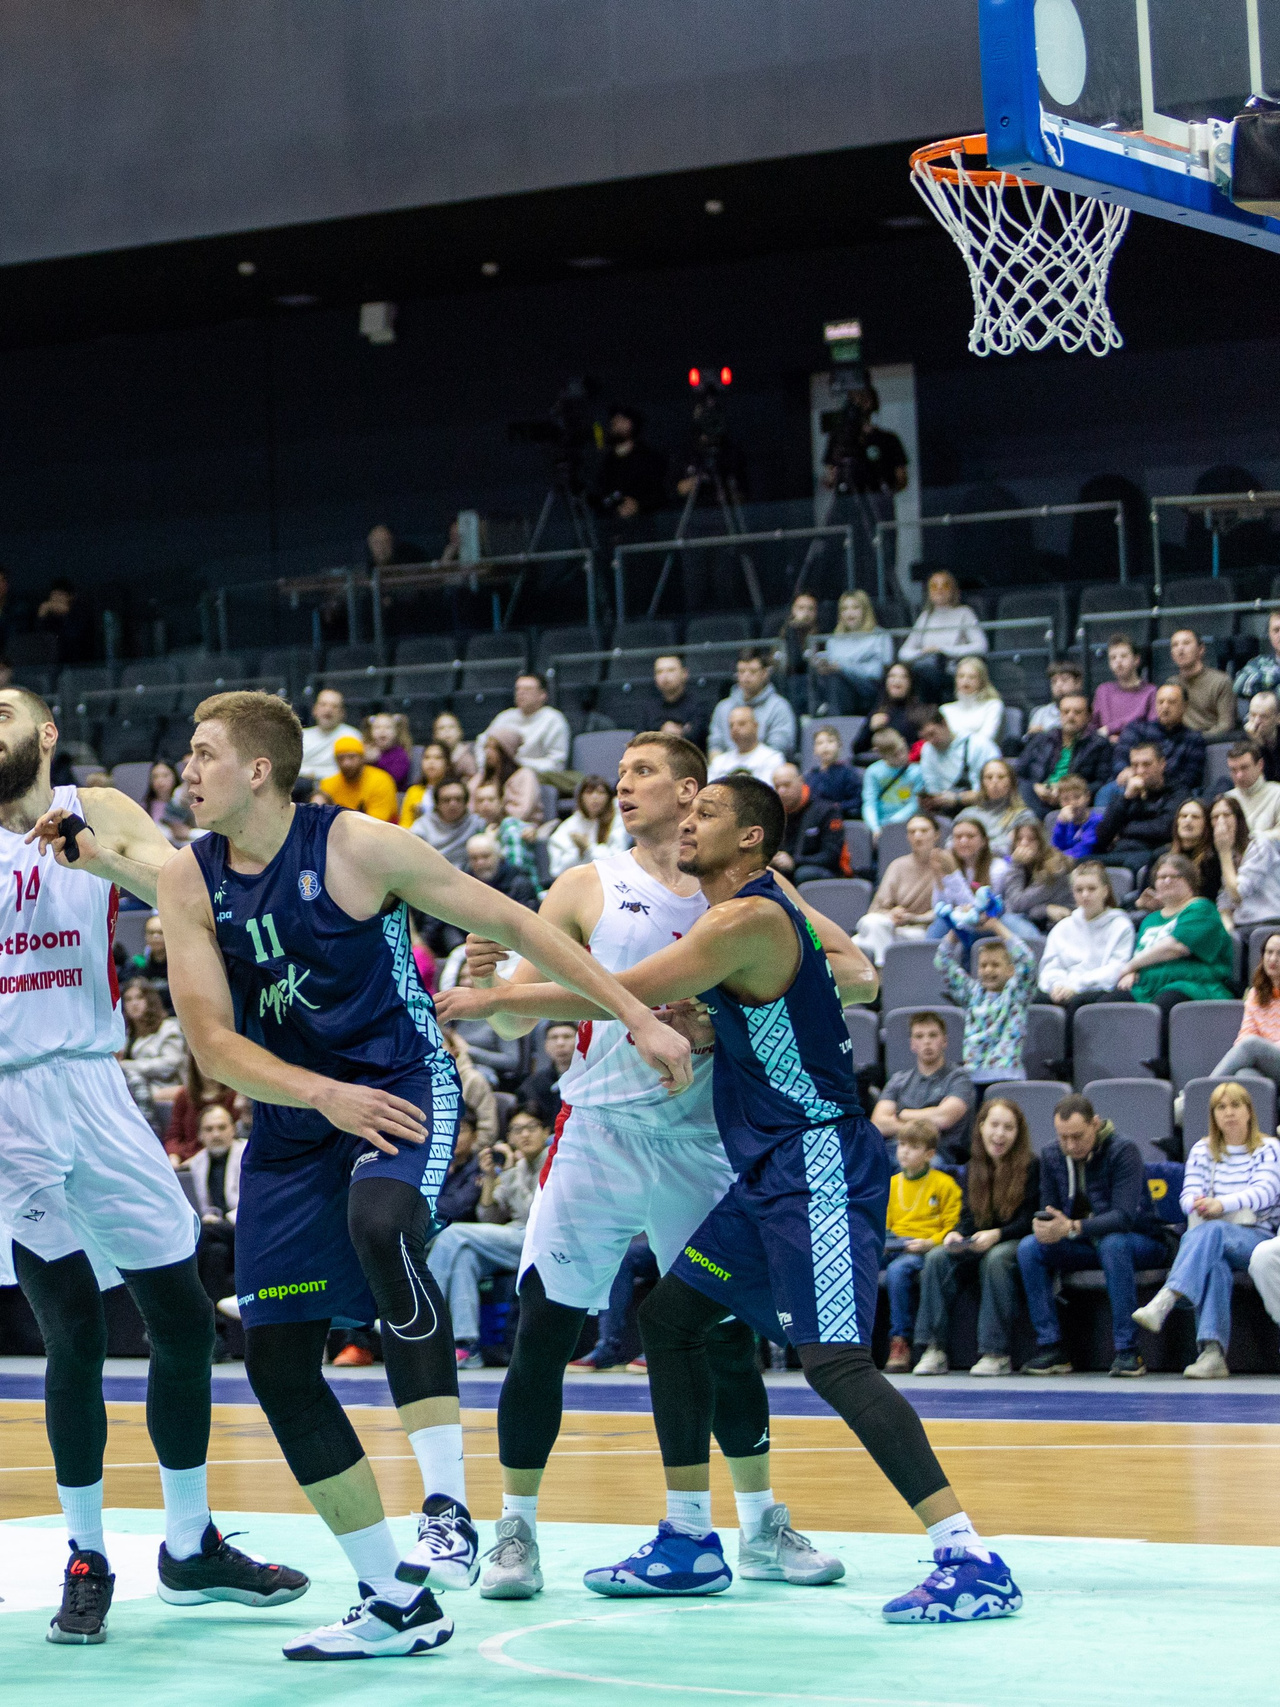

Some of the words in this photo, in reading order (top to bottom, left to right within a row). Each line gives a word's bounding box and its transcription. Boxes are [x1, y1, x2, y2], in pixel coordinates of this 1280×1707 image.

[13, 865, 41, 912] 14
[245, 913, 285, 963] 11
[684, 1246, 732, 1281] евроопт
[258, 1280, 327, 1300] евроопт
